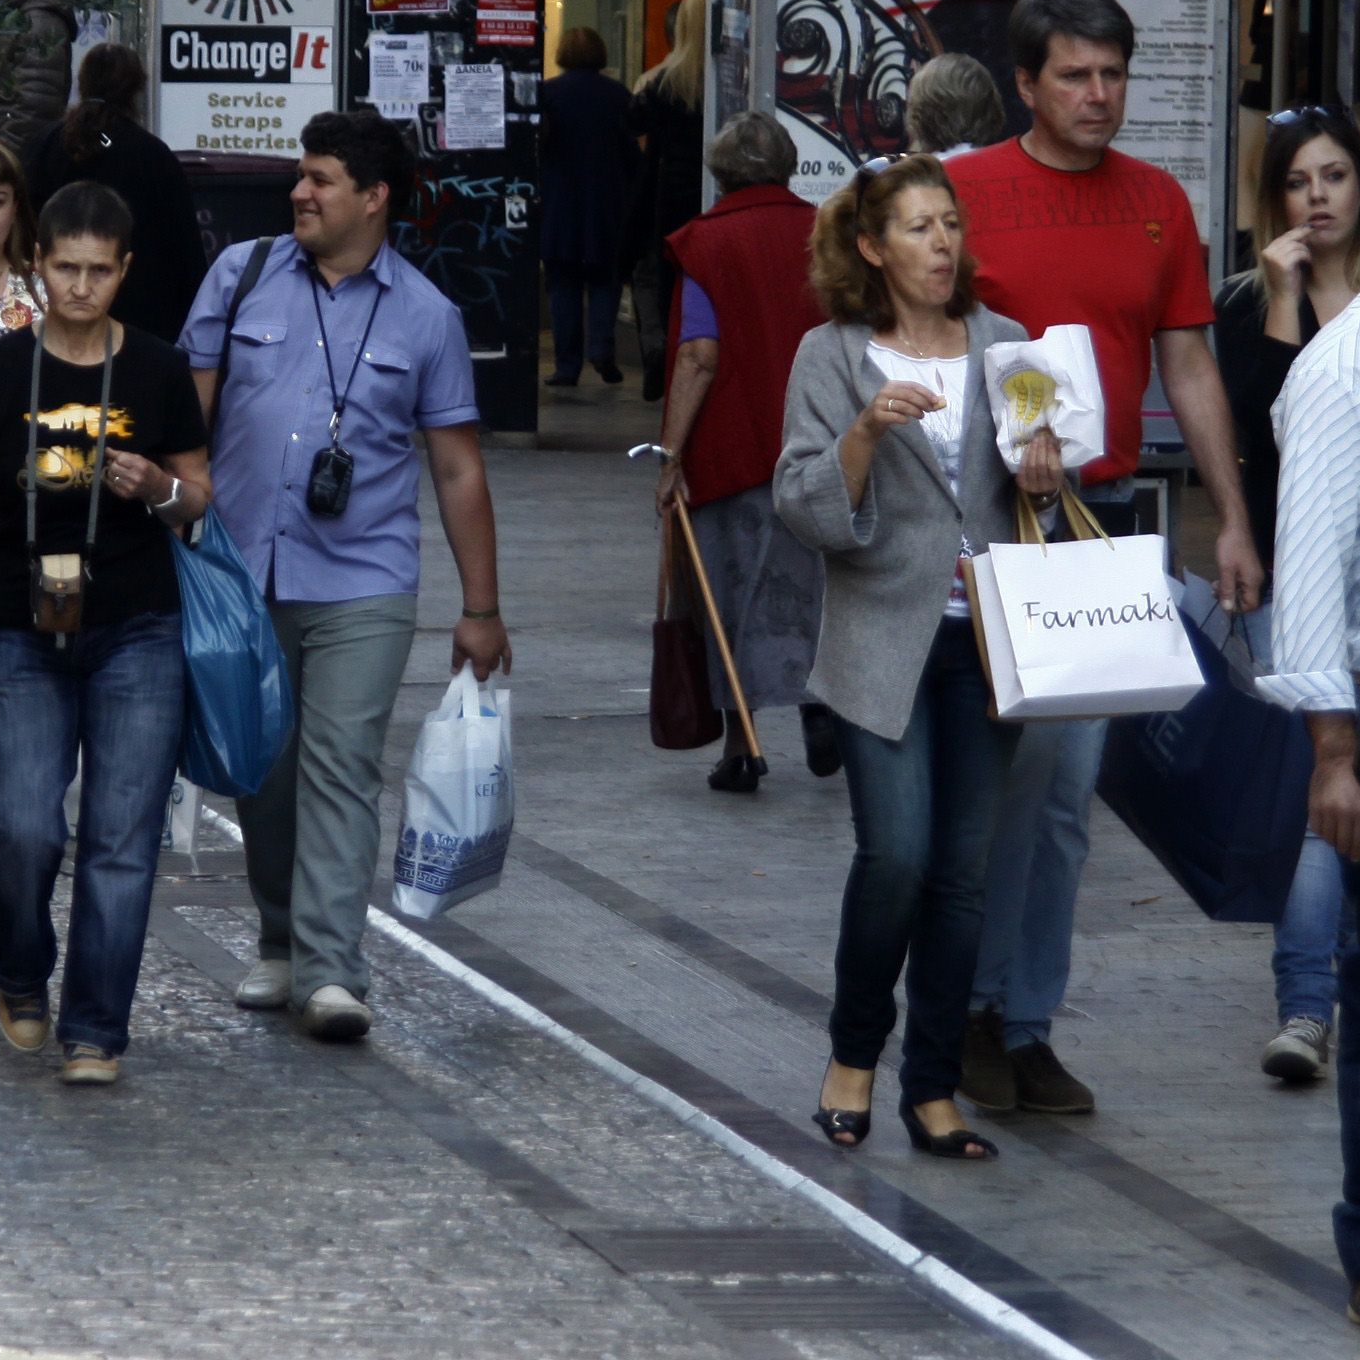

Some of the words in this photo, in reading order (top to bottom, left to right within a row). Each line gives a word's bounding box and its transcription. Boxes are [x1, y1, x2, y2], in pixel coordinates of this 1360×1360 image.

[169, 31, 286, 78] Change
[207, 92, 287, 108] Service
[211, 112, 283, 131] Straps
[196, 134, 298, 150] Batteries
